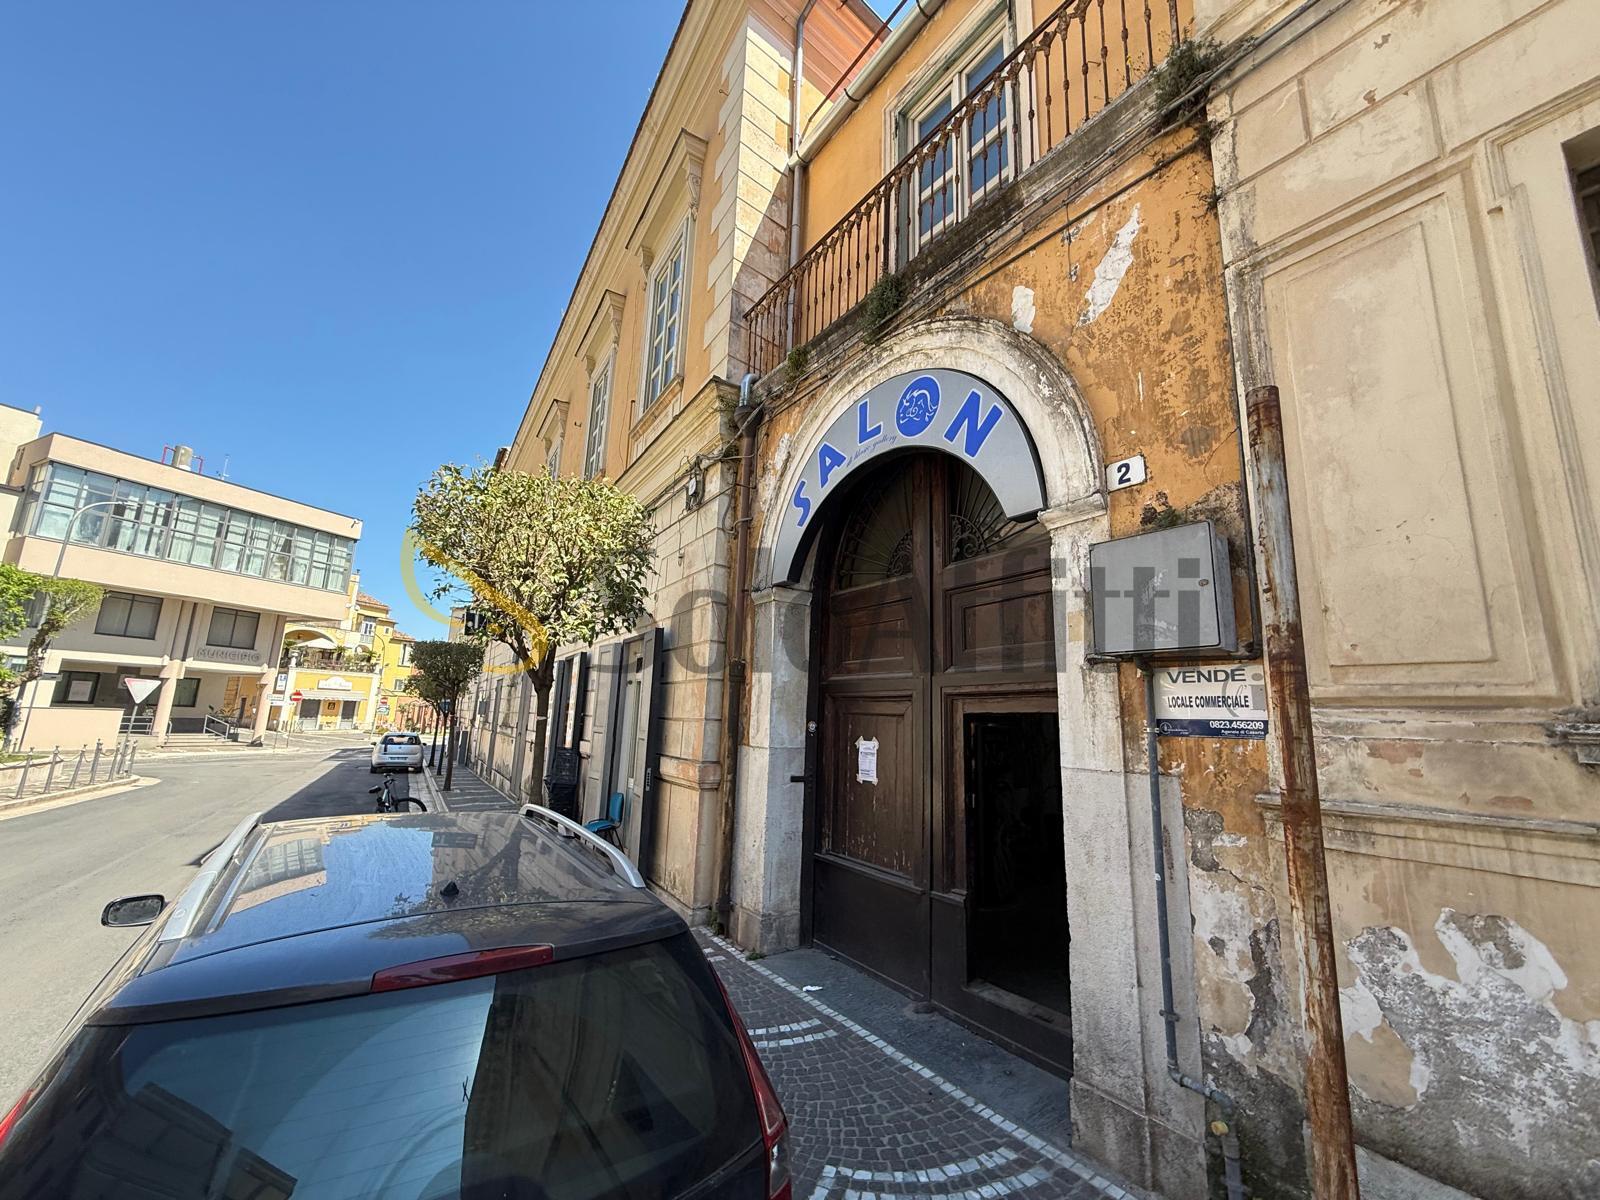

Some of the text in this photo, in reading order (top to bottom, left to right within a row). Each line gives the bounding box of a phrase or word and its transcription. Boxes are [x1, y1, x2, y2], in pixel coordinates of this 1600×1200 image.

[793, 375, 1003, 528] SALON
[1117, 463, 1131, 485] 2
[1167, 669, 1247, 683] VENDE
[1168, 696, 1249, 708] LOCALE COMMERCIALE
[1209, 720, 1264, 729] 0823.456209
